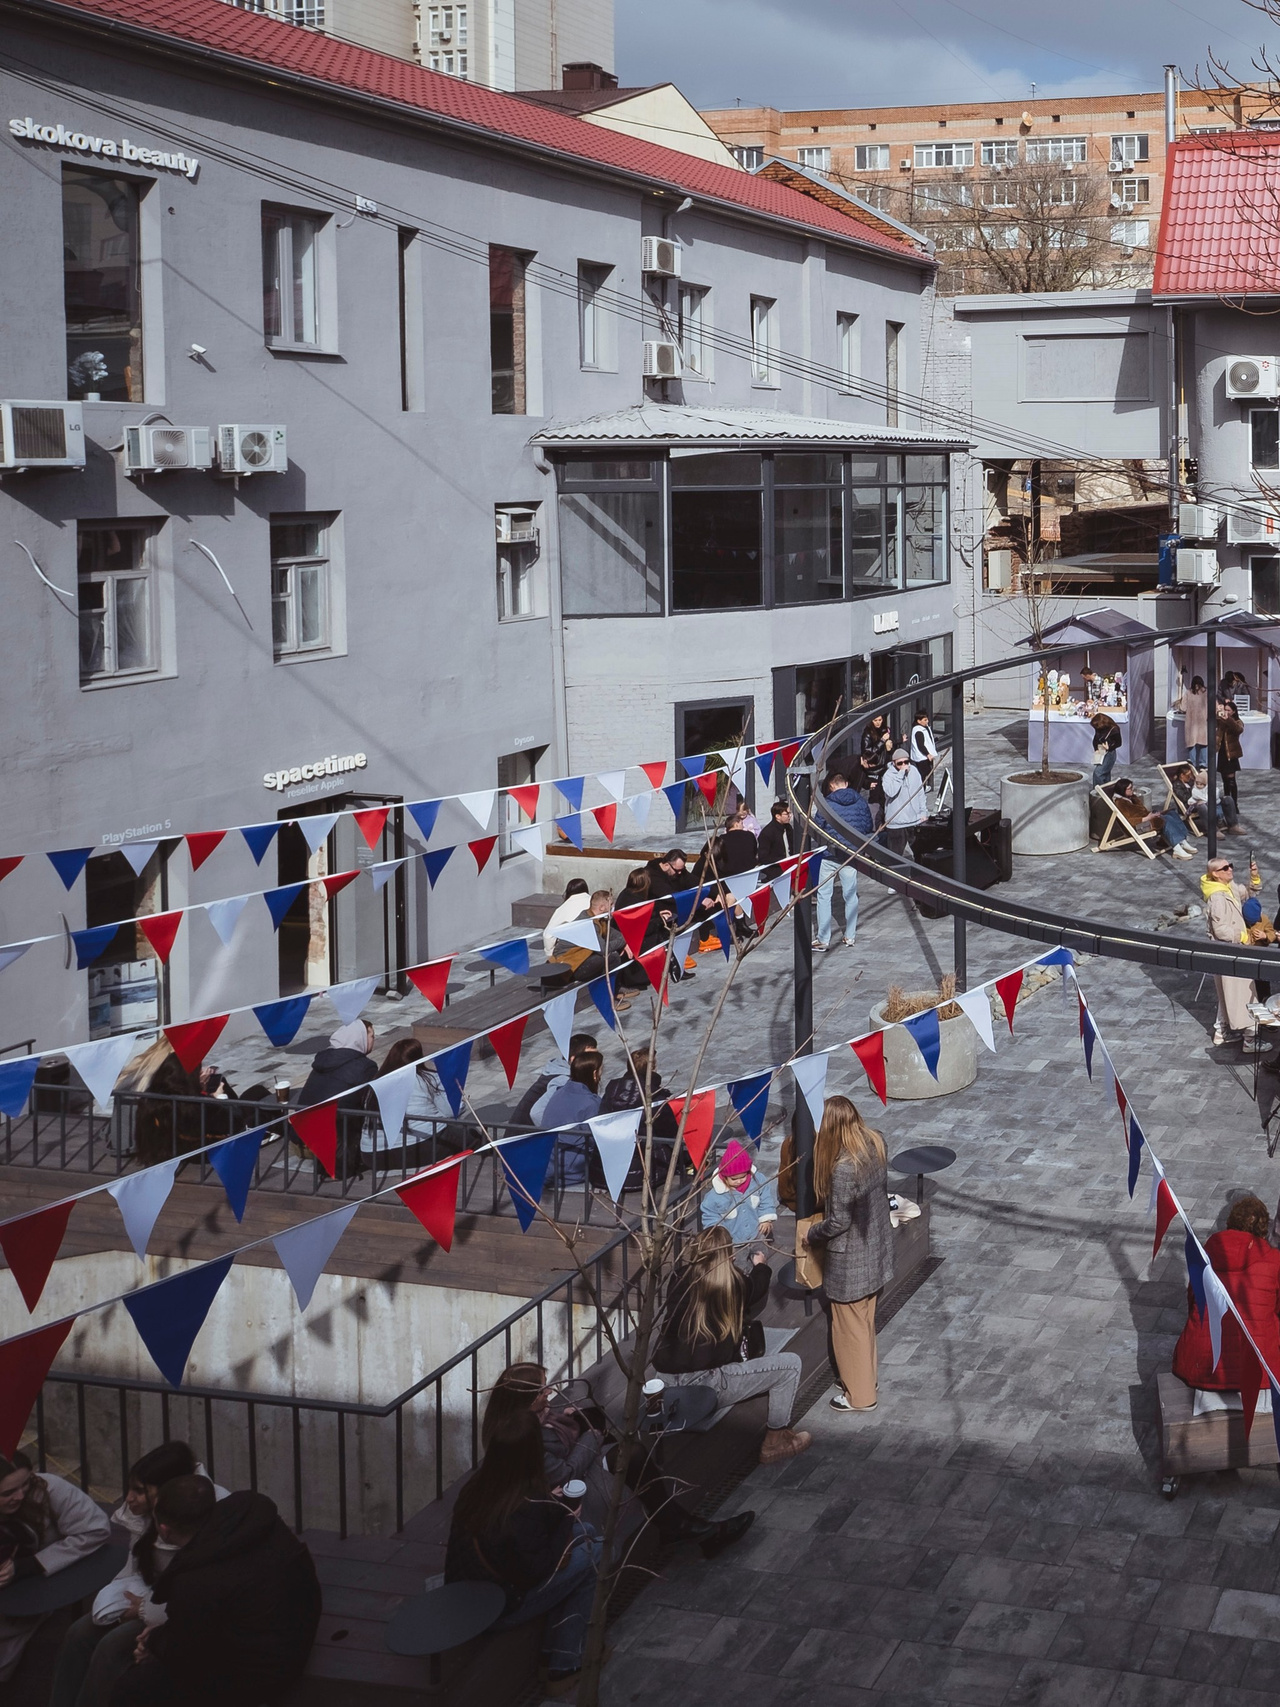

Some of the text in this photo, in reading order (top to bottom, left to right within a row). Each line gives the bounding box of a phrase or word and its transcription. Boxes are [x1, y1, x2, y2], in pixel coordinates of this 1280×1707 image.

[8, 117, 199, 178] skokova beauty
[514, 735, 535, 746] Dyson
[262, 751, 368, 791] spacetime
[287, 777, 345, 799] reseller Apple
[102, 818, 171, 844] PlayStation 5
